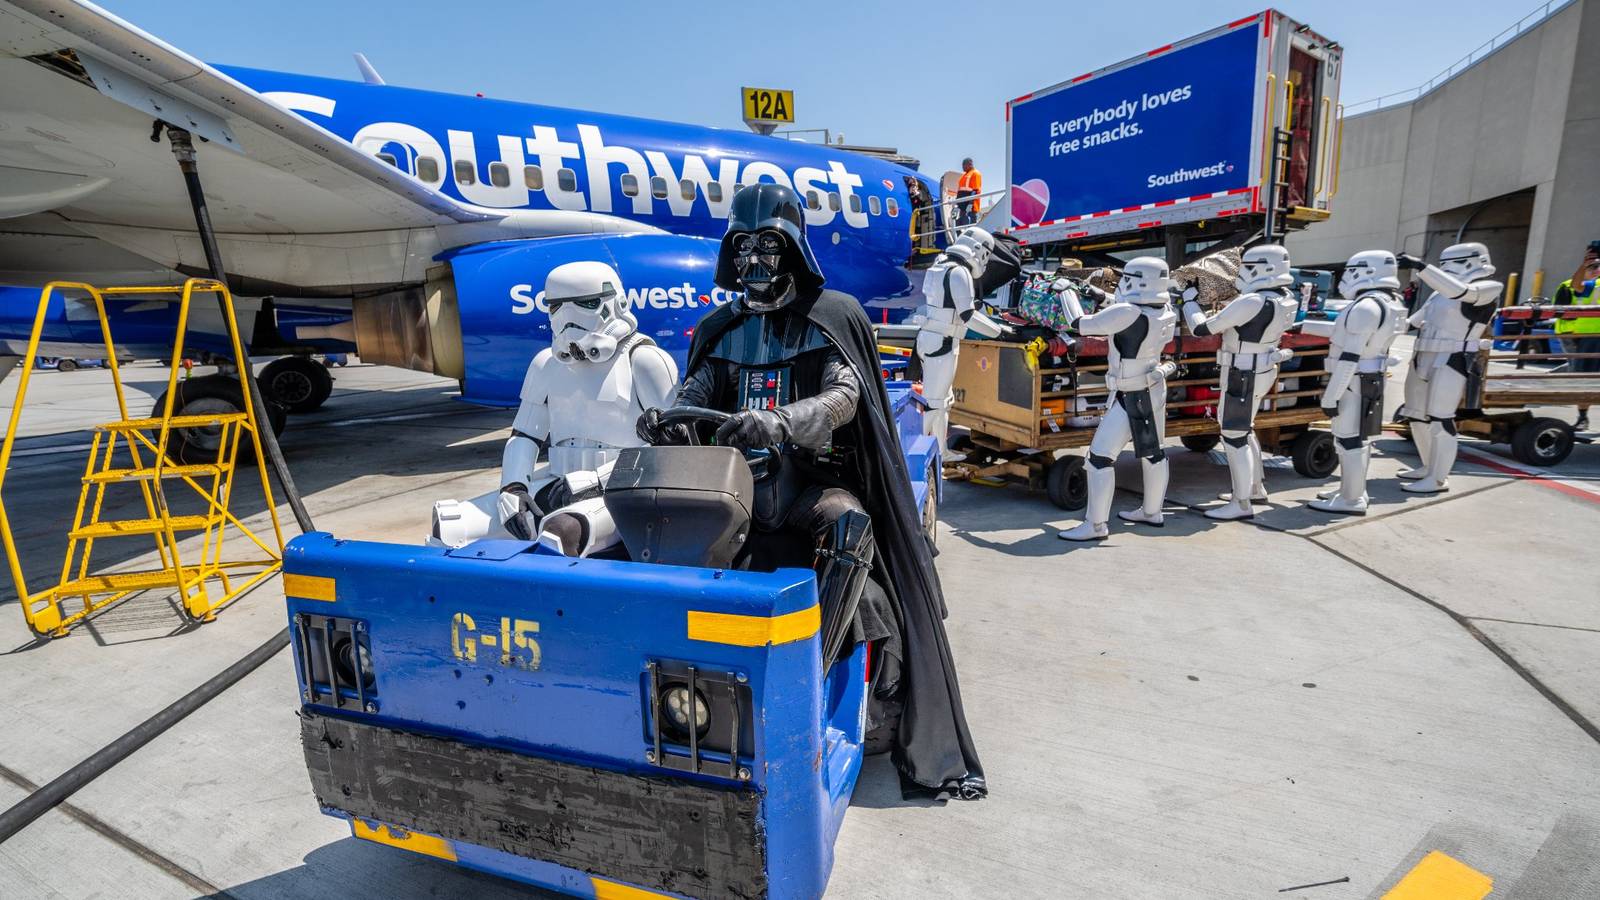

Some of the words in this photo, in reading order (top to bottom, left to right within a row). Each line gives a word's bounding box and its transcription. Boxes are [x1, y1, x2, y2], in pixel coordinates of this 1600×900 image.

[750, 91, 788, 120] 12A
[1050, 100, 1138, 137] Everybody
[1142, 84, 1192, 111] loves
[1049, 139, 1080, 157] free
[1083, 122, 1144, 149] snacks.
[1147, 161, 1225, 188] Southwest
[451, 612, 542, 670] G-15
